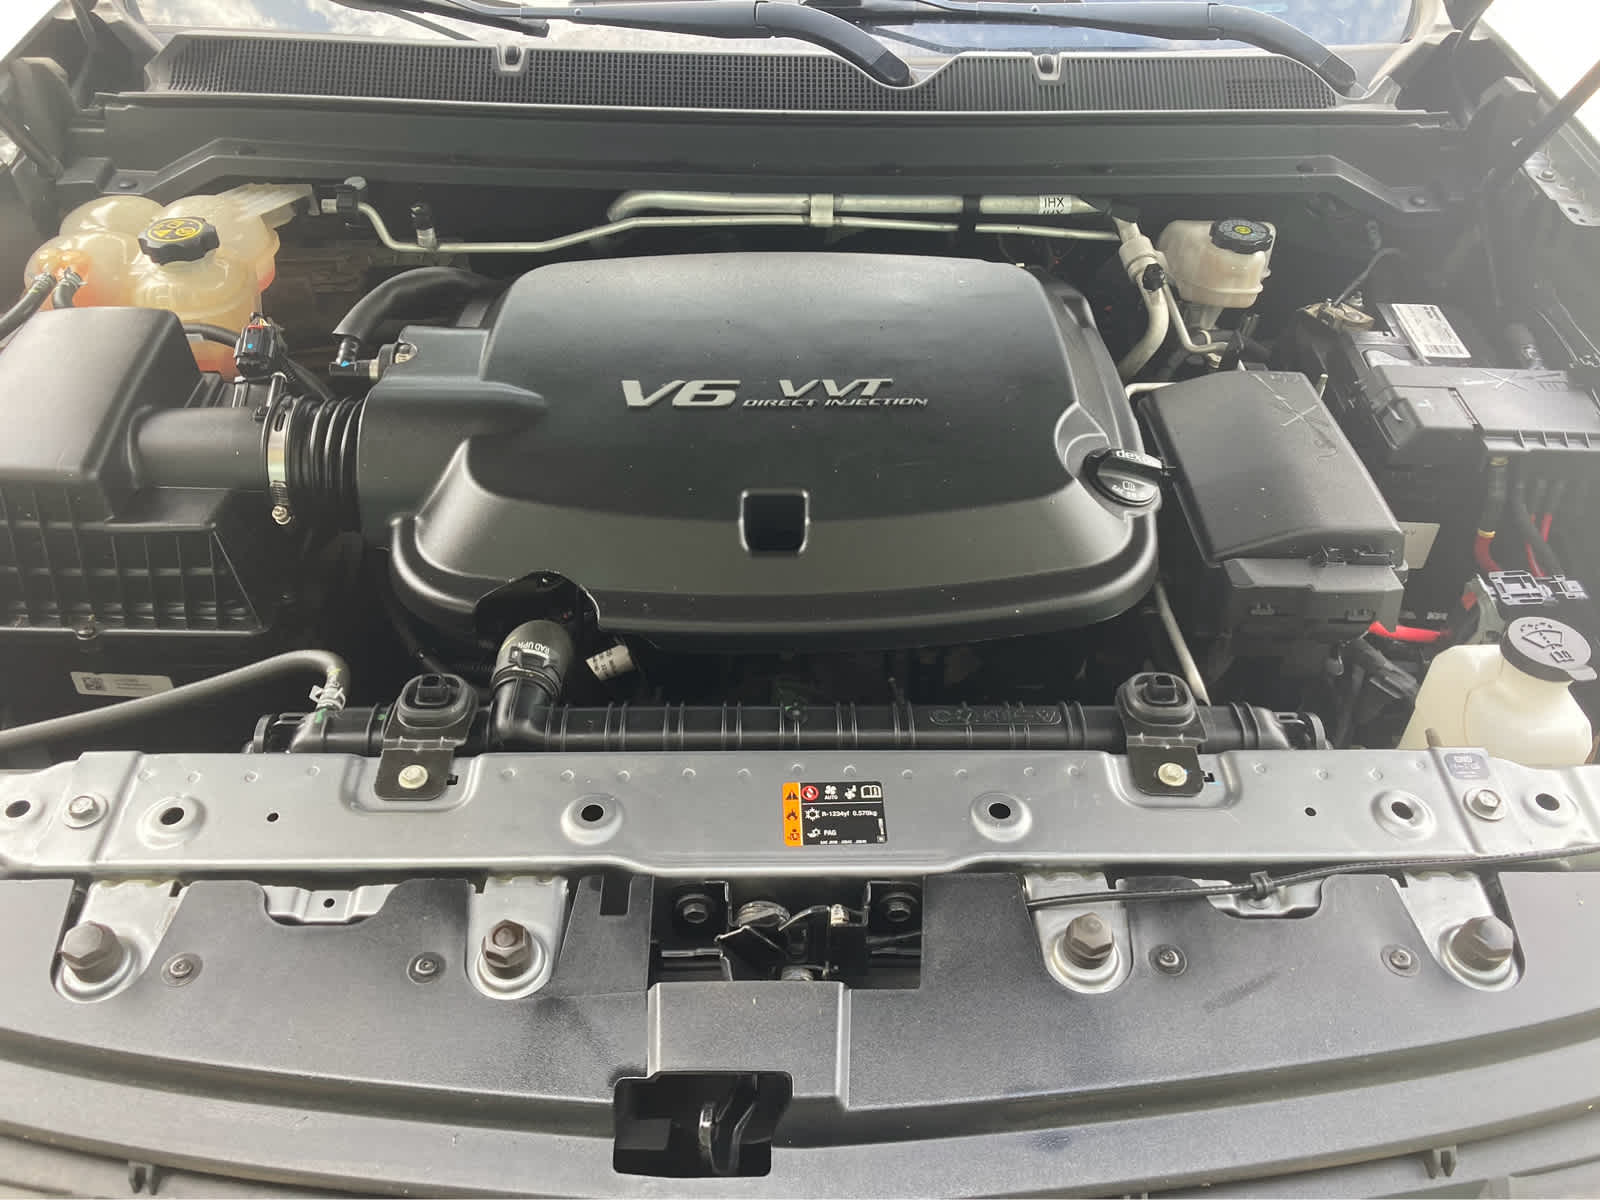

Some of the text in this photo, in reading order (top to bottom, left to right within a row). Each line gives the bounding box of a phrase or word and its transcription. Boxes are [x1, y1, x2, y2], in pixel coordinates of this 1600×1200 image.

[1044, 196, 1065, 208] IHX
[621, 379, 741, 407] V6
[779, 378, 894, 397] VVT
[742, 398, 929, 407] DIRECT INJECTION
